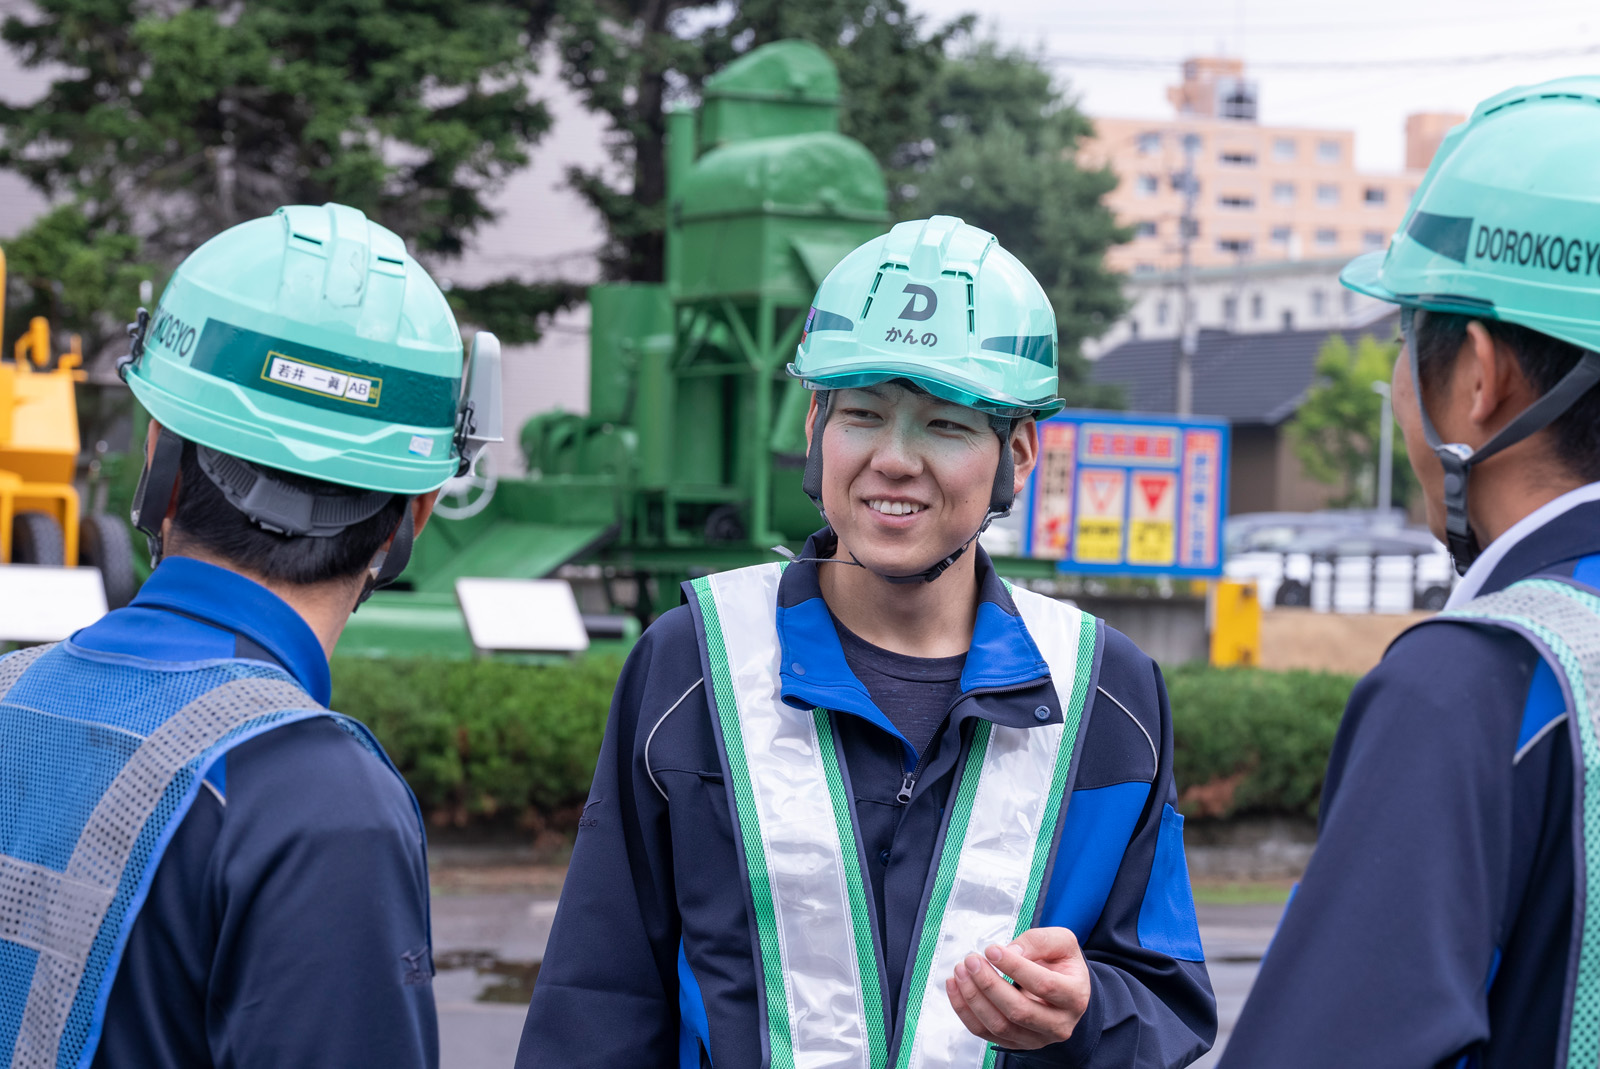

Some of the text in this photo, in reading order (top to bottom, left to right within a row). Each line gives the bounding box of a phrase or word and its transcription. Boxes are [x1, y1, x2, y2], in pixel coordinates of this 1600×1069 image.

[1475, 225, 1600, 277] DOROKOGY
[898, 283, 938, 321] D
[885, 327, 938, 347] かんの
[278, 364, 306, 381] 若井
[348, 382, 368, 396] AB
